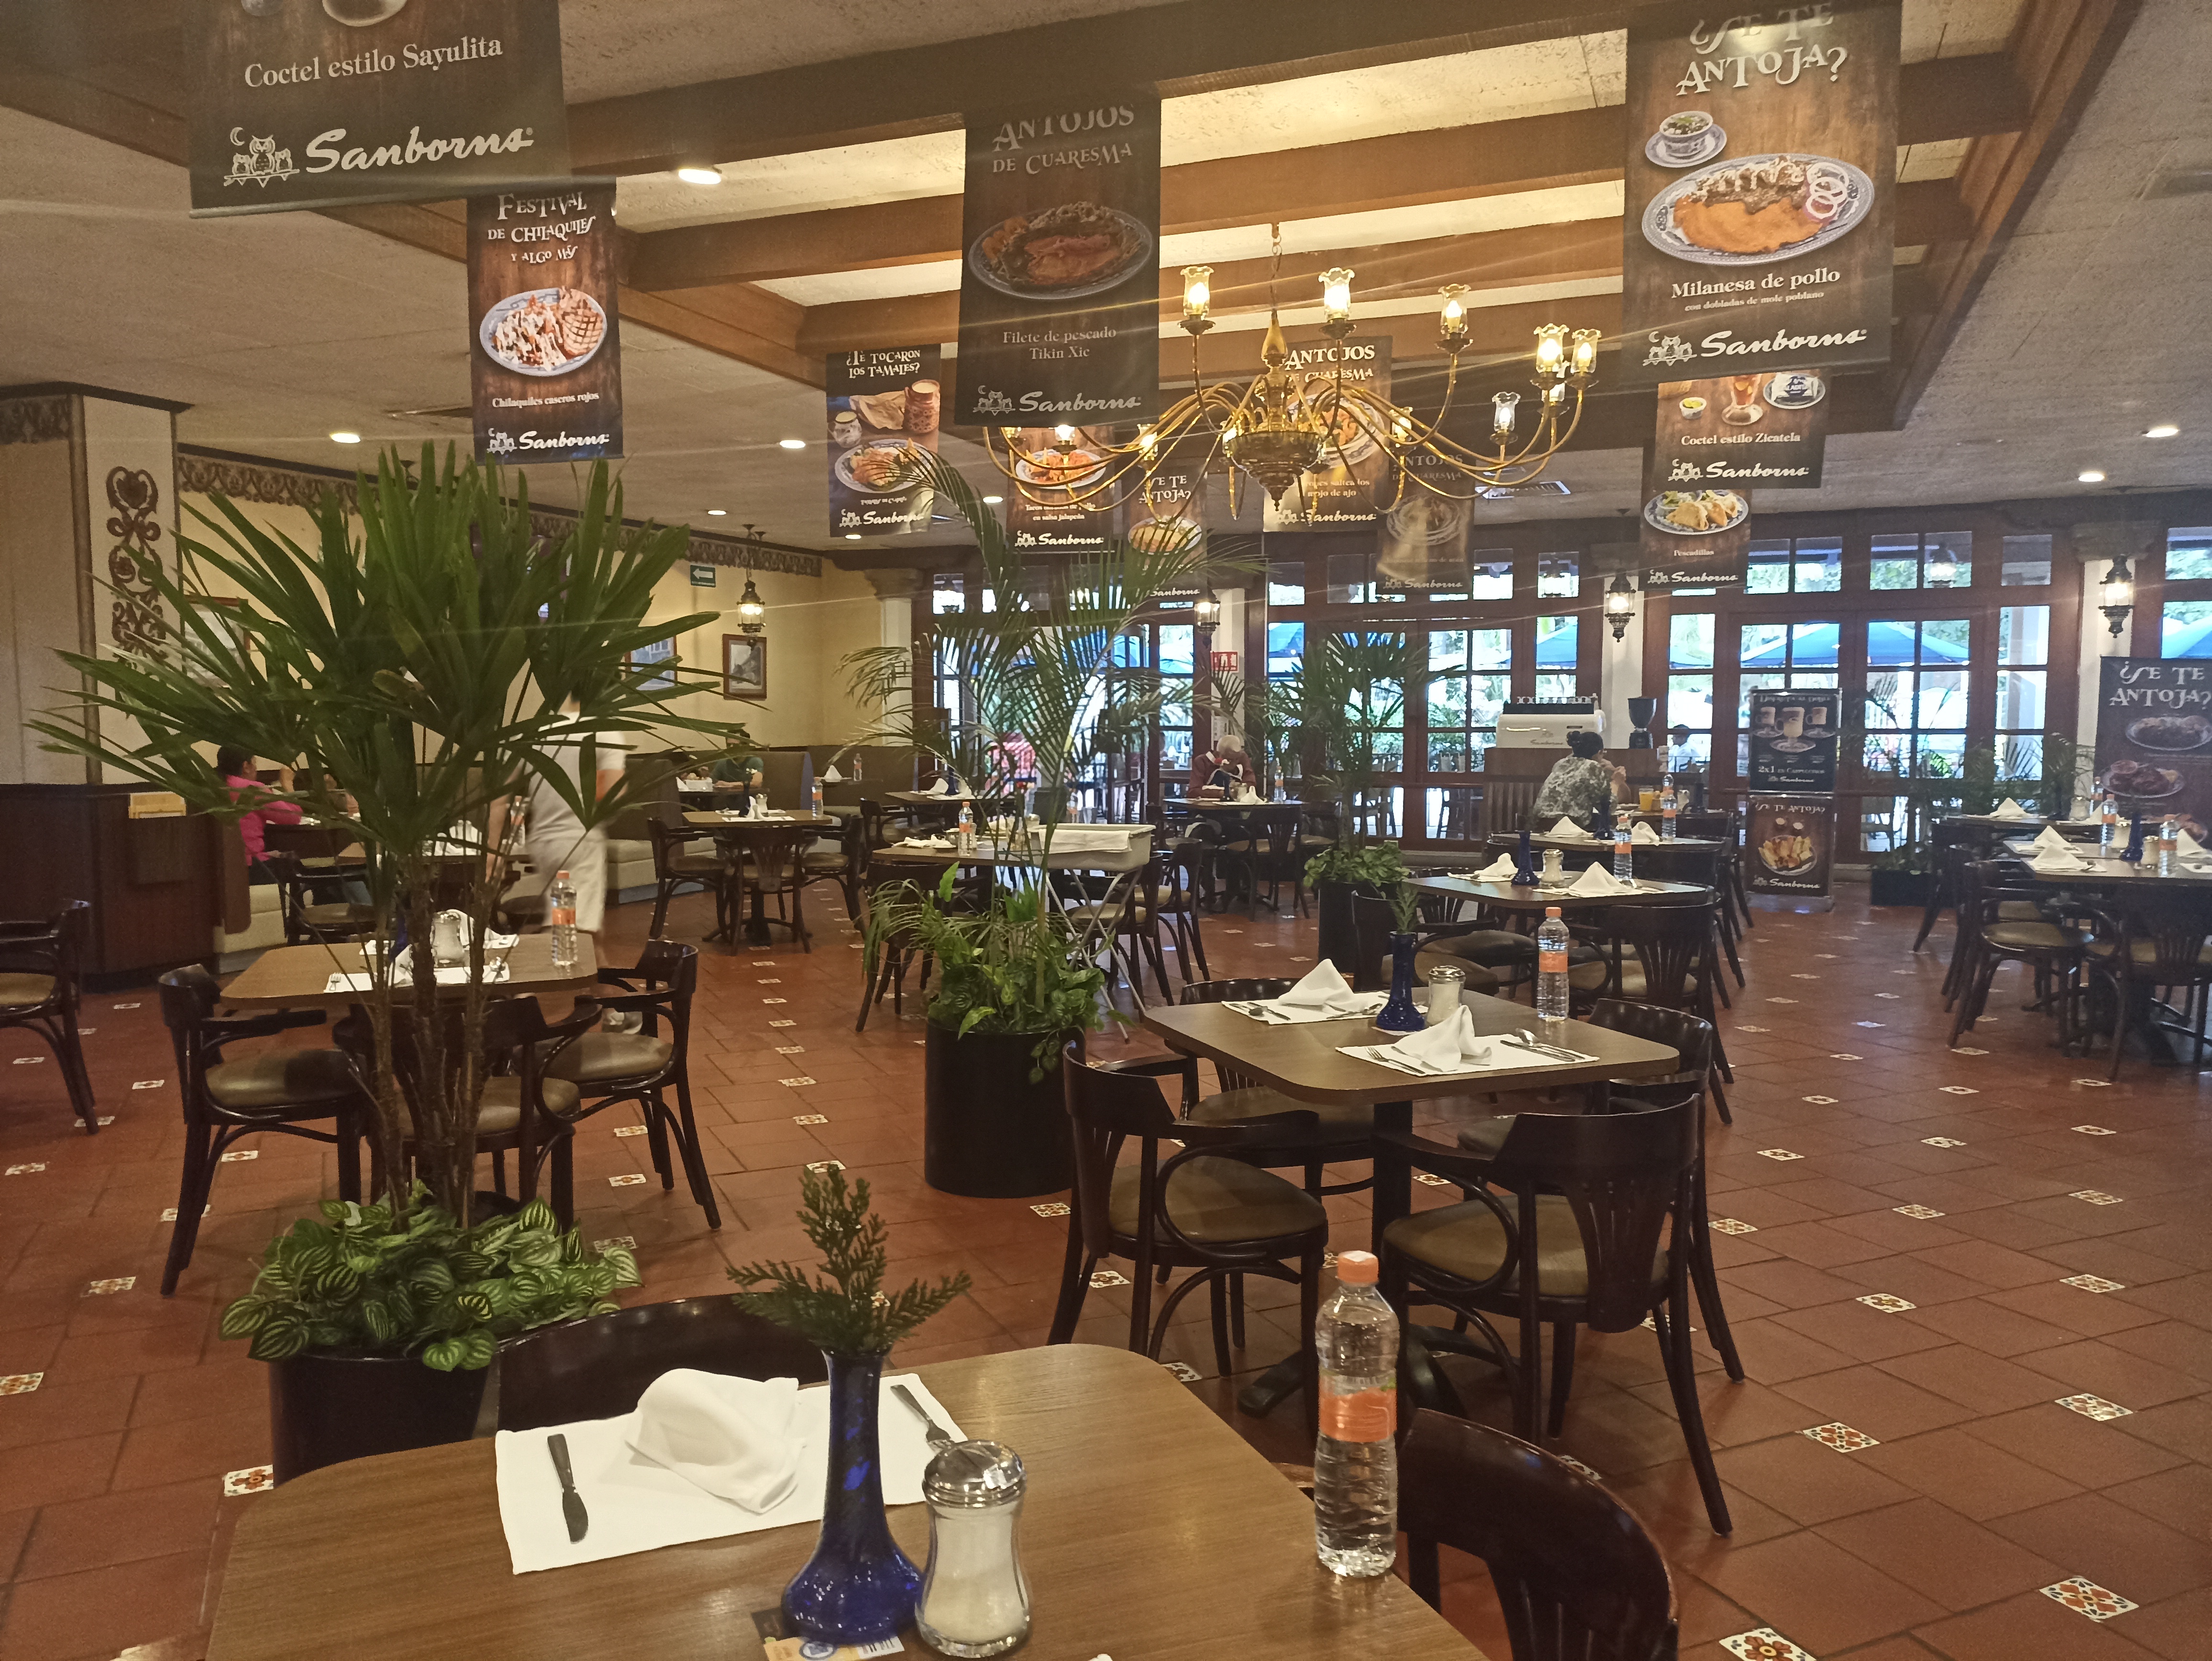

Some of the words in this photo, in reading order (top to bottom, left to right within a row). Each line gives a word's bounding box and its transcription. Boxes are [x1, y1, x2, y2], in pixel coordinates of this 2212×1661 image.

[1777, 2, 1834, 42] TE
[245, 57, 321, 87] Coctel
[328, 49, 395, 78] estilo
[403, 36, 503, 71] Sayulita
[1675, 44, 1847, 96] ANTOJA?
[993, 103, 1134, 152] ANTOJOS
[306, 126, 534, 173] Sanborns
[993, 157, 1016, 173] DE
[1026, 142, 1133, 175] CUARESMA
[497, 191, 587, 220] FESTIVAL
[487, 228, 506, 240] DE
[511, 215, 596, 243] CHILAQUILES
[511, 253, 517, 261] Y
[521, 250, 552, 264] ALGO
[1671, 280, 1756, 298] Milanesa
[1761, 273, 1784, 288] de
[1790, 267, 1840, 290] pollo
[1703, 299, 1745, 309] dobladas
[1747, 297, 1758, 305] de
[1761, 295, 1783, 304] mole
[1785, 291, 1824, 302] poblano
[1003, 331, 1040, 344] Filete
[1044, 329, 1060, 342] de
[1064, 326, 1117, 343] pescado
[1701, 329, 1867, 357] Sanborns
[870, 350, 920, 364] TOCARON
[1029, 346, 1064, 360] Tikin
[1068, 345, 1090, 359] Xic
[849, 367, 865, 378] LOS
[867, 362, 920, 377] TAMALES?
[577, 392, 599, 403] rojos
[1019, 390, 1141, 412] Sanborns
[519, 431, 609, 449] Sanborns
[1681, 435, 1717, 445] Coctel
[1720, 433, 1753, 443] estilo
[1706, 461, 1809, 477] Sanborns
[1169, 475, 1187, 487] TE
[1343, 489, 1357, 498] ajo
[1039, 533, 1104, 545] Sanborns
[1671, 571, 1738, 582] Sanborns
[2120, 661, 2161, 684] ¿SE
[2172, 667, 2205, 685] TE
[2109, 688, 2212, 710] ANTOJA?
